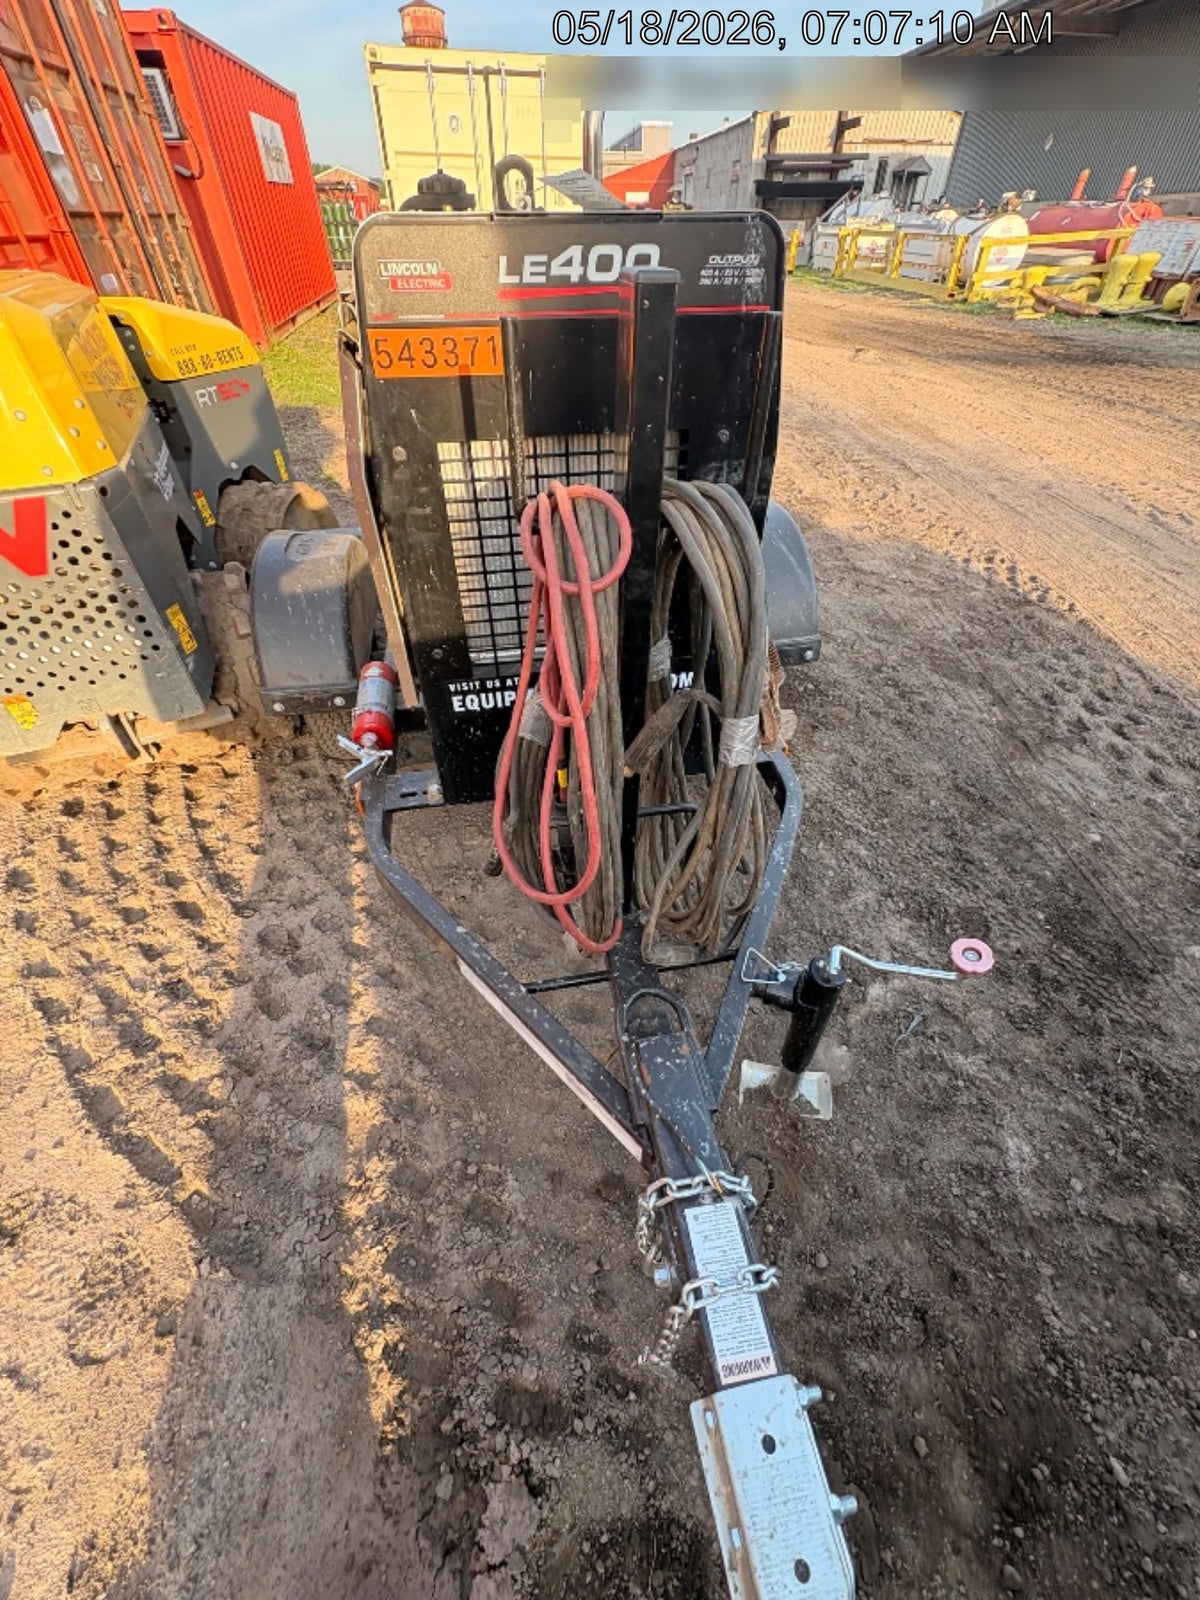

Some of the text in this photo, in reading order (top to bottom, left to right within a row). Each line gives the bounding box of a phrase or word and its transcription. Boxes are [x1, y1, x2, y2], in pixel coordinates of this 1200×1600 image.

[498, 243, 661, 284] LE400
[708, 255, 760, 264] OUTPUT
[379, 262, 438, 276] LINCOLN
[397, 278, 447, 289] ELECTRIC
[374, 336, 498, 369] 543371
[448, 677, 520, 692] VISIT US AT
